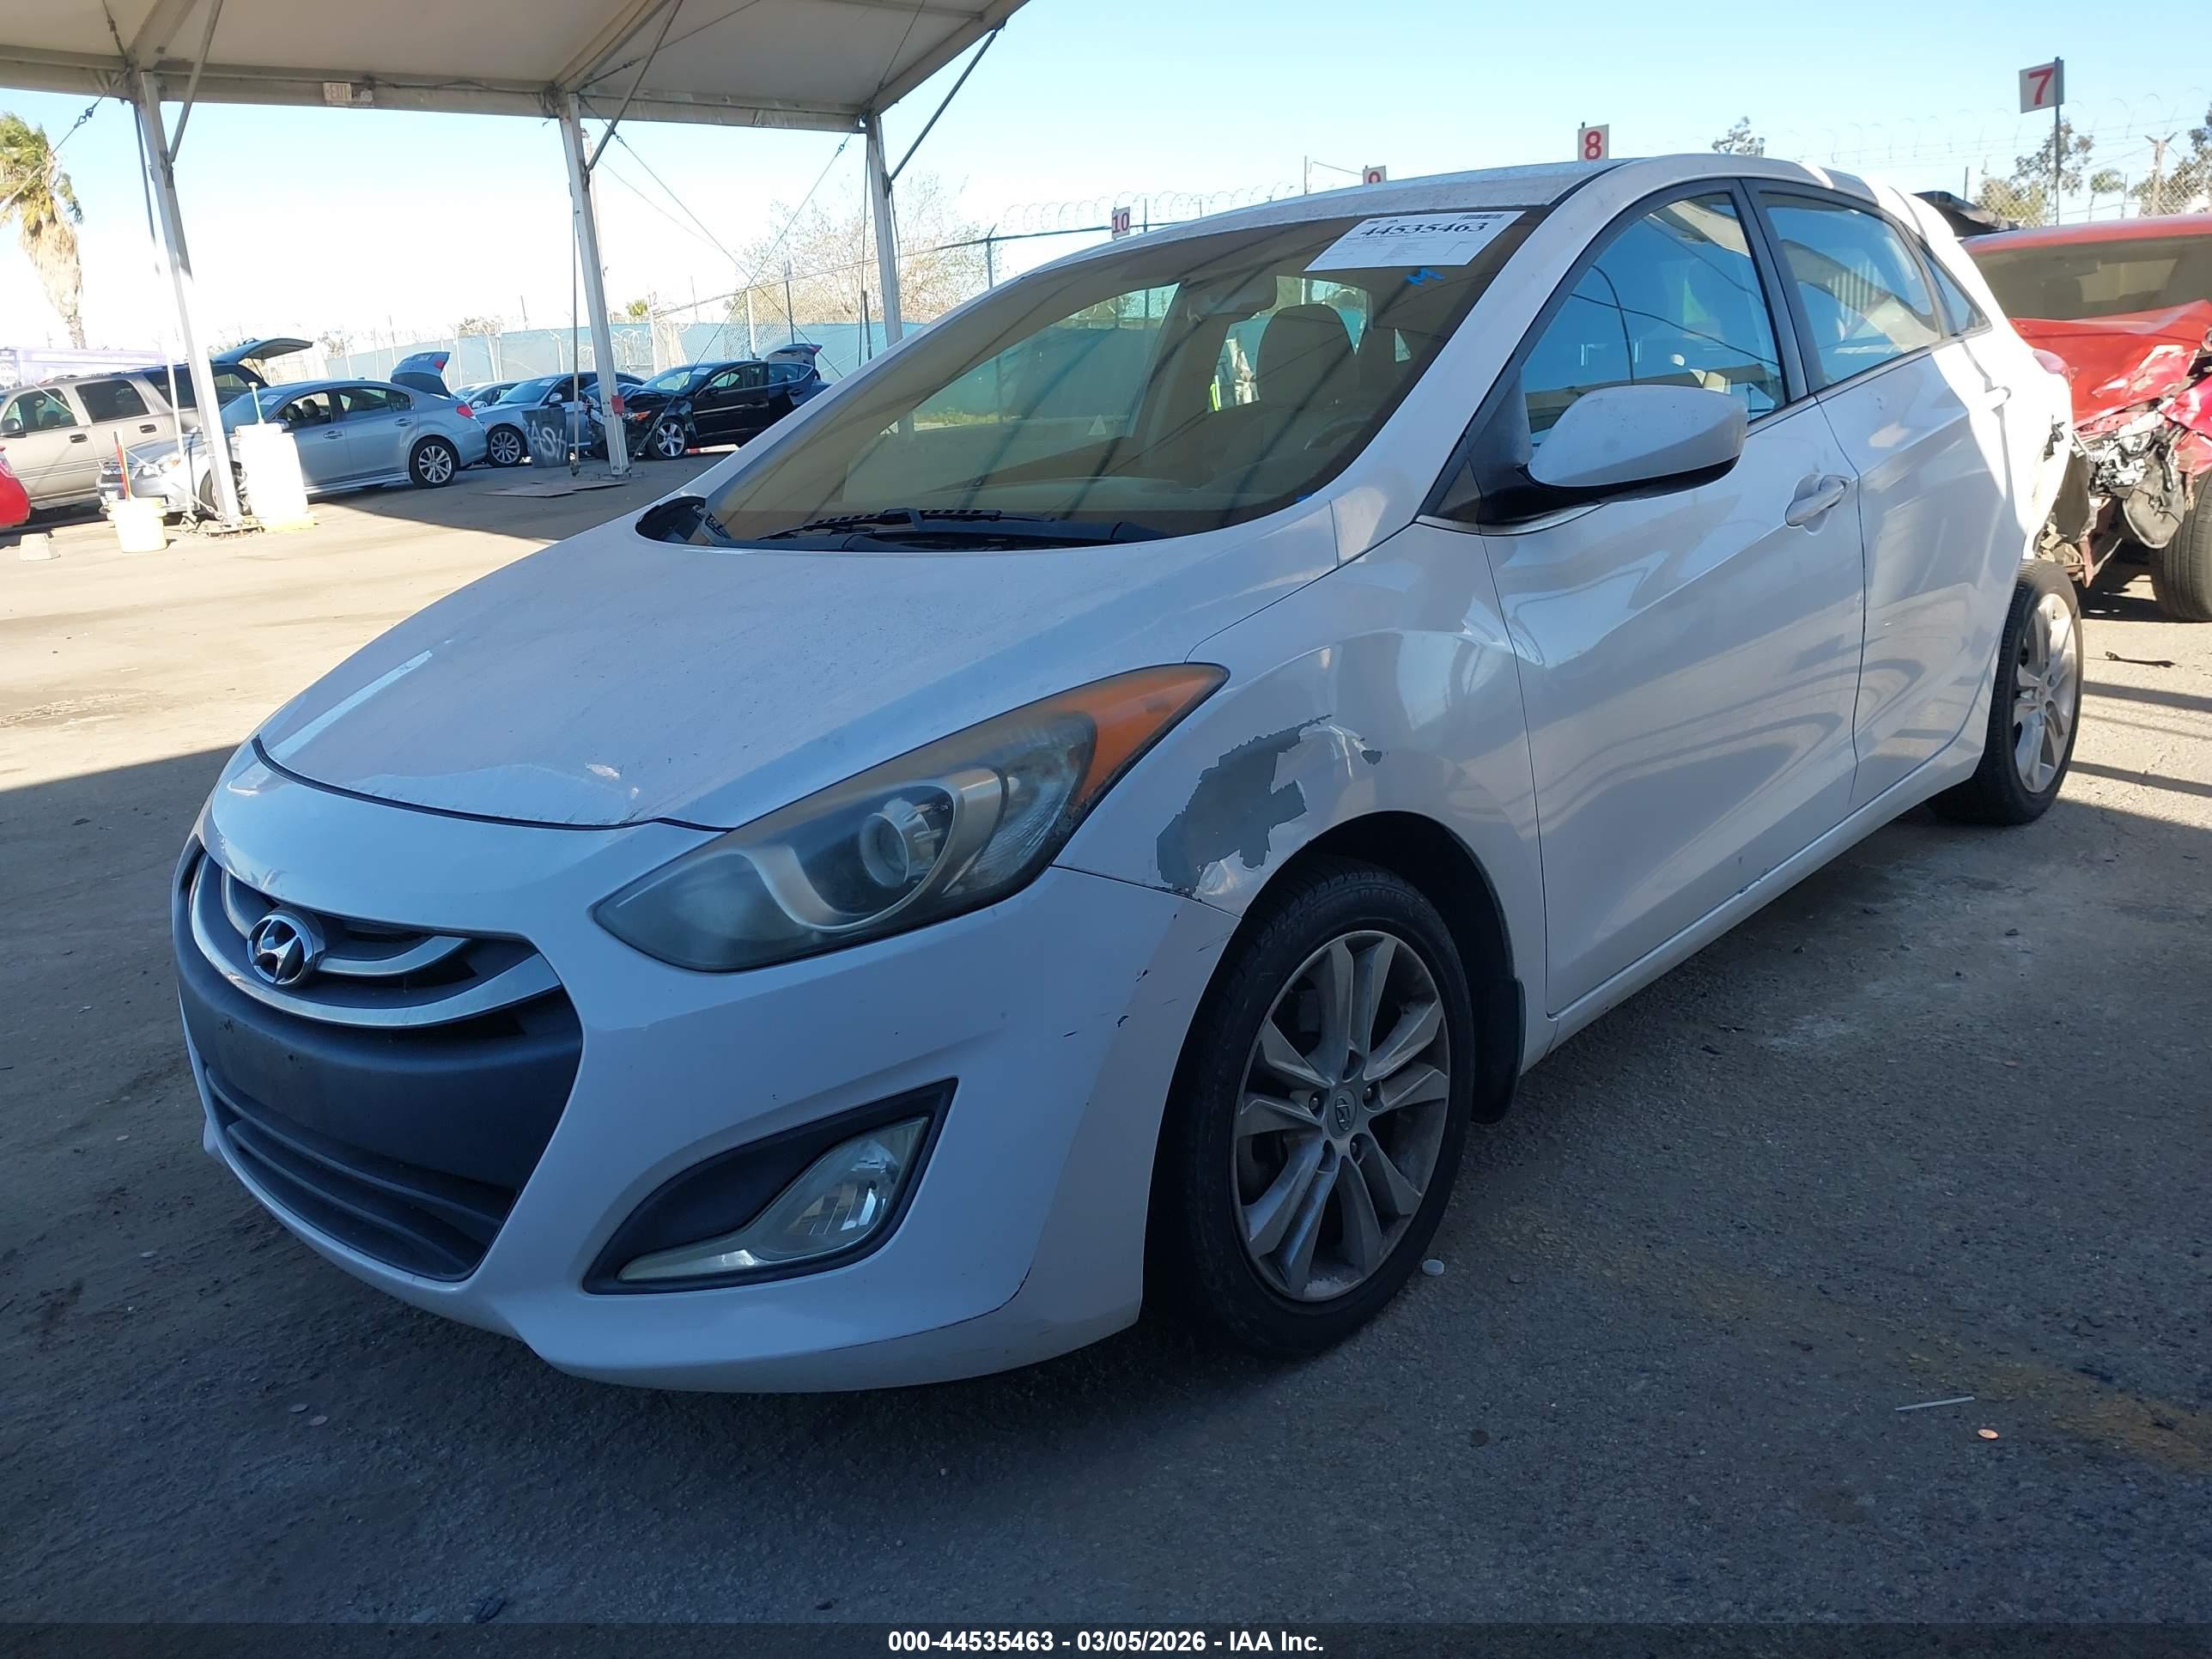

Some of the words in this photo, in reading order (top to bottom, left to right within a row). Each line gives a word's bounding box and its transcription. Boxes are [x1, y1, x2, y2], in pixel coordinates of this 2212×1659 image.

[2028, 67, 2055, 106] 7
[1584, 131, 1602, 160] 8
[1112, 212, 1130, 234] 10
[1361, 222, 1489, 235] 44535463
[647, 291, 658, 307] 12
